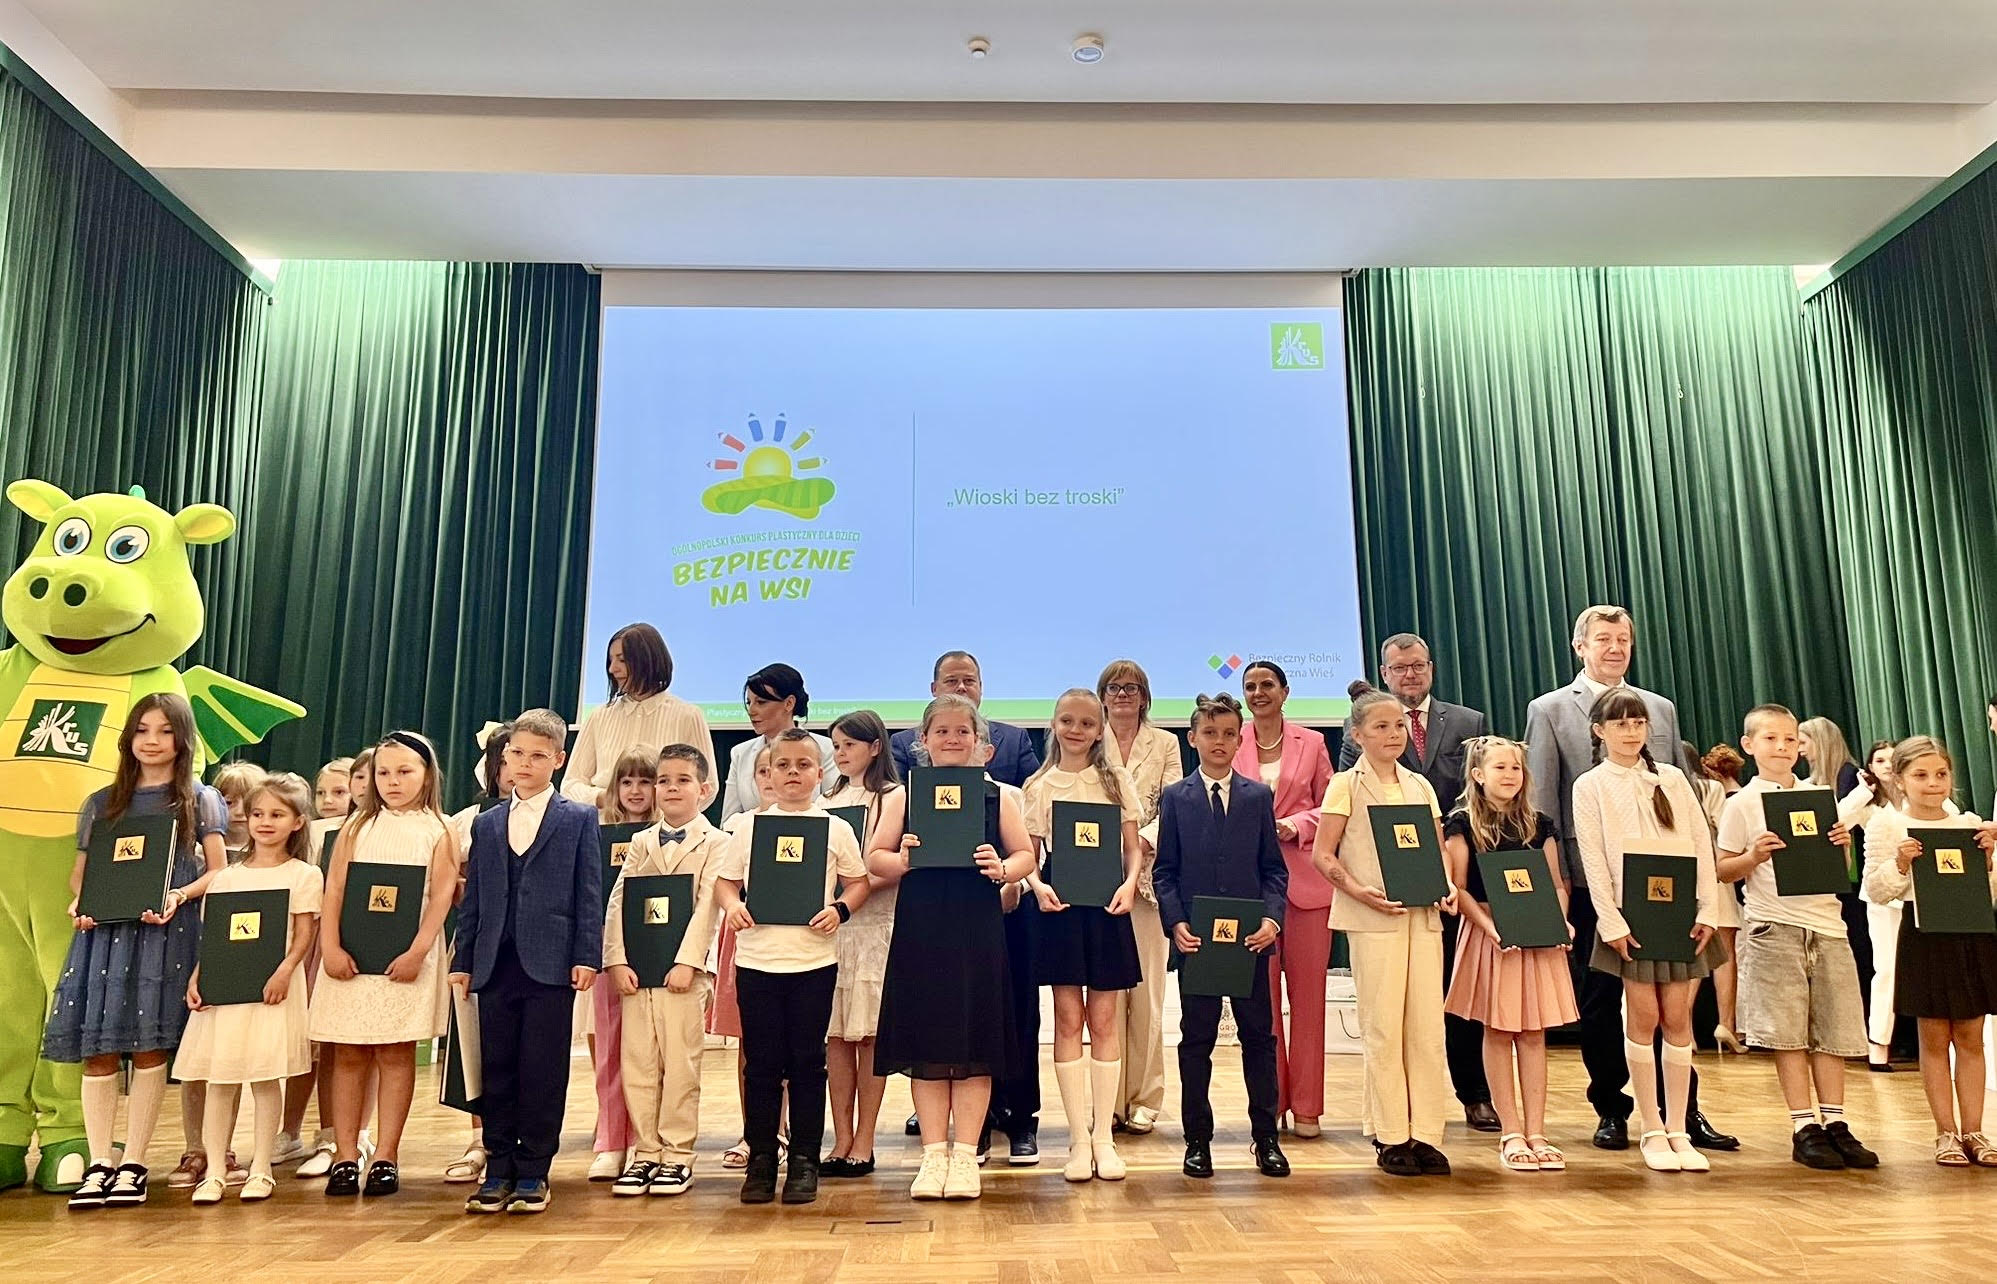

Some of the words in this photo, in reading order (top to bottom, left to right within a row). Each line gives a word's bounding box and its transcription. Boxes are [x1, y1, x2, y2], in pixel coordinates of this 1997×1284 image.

[1025, 488, 1060, 505] bez
[730, 532, 767, 545] KONKURS
[768, 530, 817, 541] PLASTYCZNY
[818, 530, 834, 541] DLA
[835, 530, 861, 542] DZIECI
[672, 547, 857, 587] BEZPIECZNIE
[710, 580, 749, 608] NA
[759, 576, 813, 601] WSI
[1308, 652, 1342, 664] Rolnik
[1309, 667, 1335, 679] Wieś
